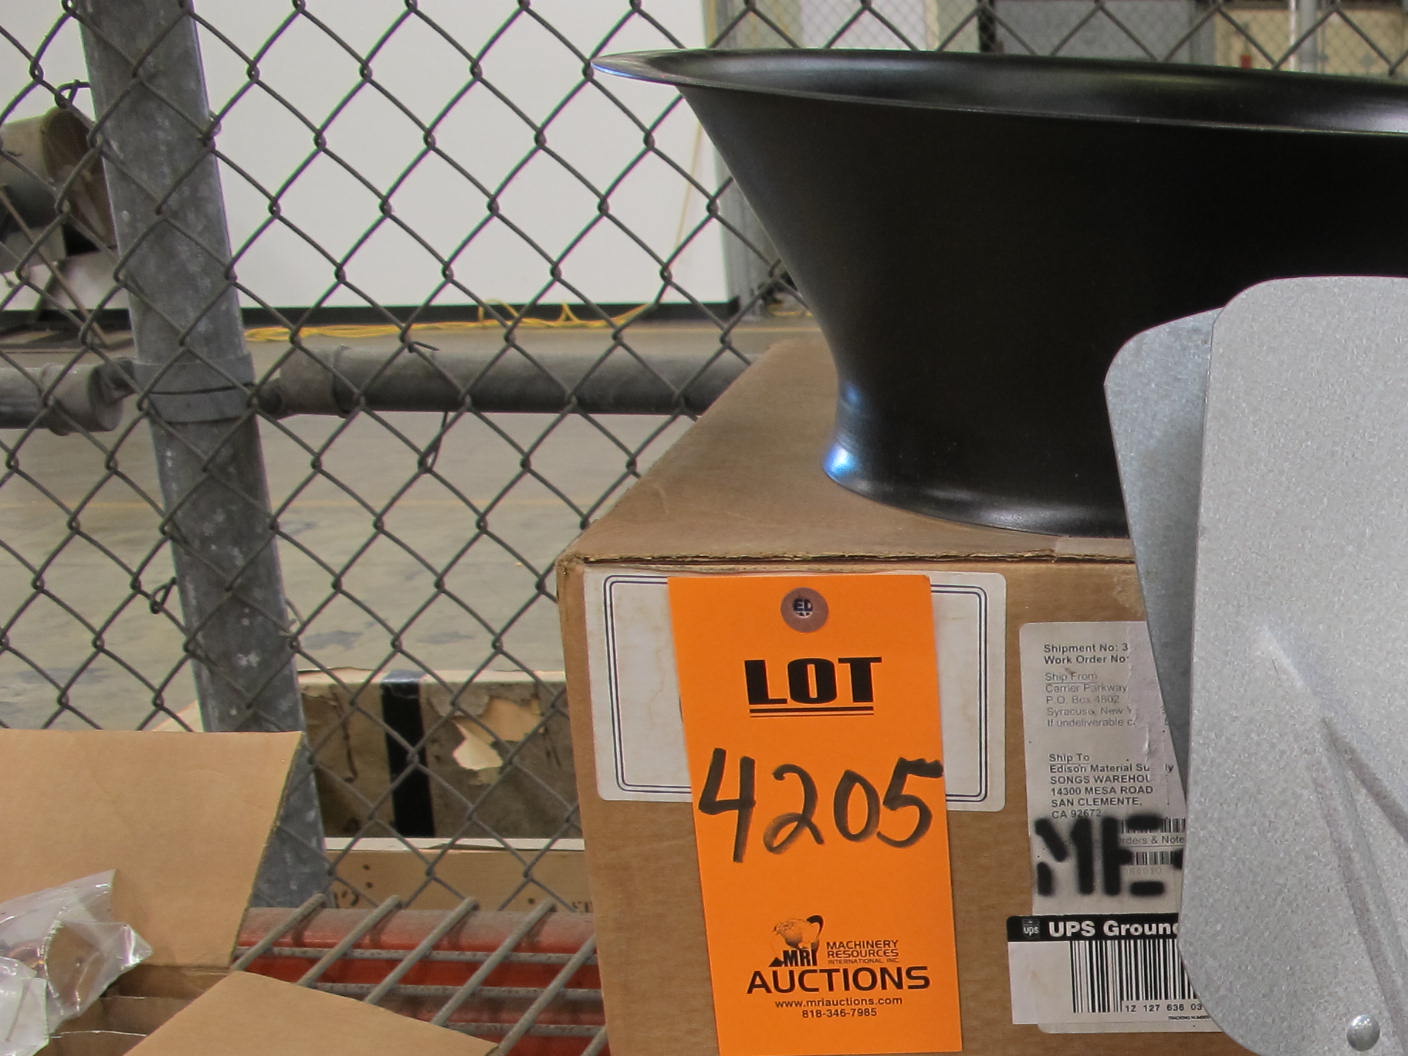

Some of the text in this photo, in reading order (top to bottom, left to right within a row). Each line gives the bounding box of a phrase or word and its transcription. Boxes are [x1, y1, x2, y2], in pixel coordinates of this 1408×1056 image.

[1044, 643, 1096, 655] Shipment
[1044, 656, 1072, 665] Work
[1076, 655, 1106, 664] Order
[744, 657, 882, 705] LOT
[1044, 672, 1098, 683] Ship From
[1045, 684, 1128, 694] Carrier Parkway
[1057, 718, 1123, 728] undeliverable
[1049, 753, 1090, 763] Ship To
[1050, 764, 1086, 774] Edison
[1090, 764, 1132, 773] Material
[1050, 775, 1151, 785] SONGS WAREHOU
[1051, 786, 1154, 796] 14300 MESA ROAD
[698, 748, 943, 863] 4205
[1052, 798, 1143, 808] SAN CLEMENTE,
[1052, 810, 1067, 819] CA
[1035, 813, 1183, 896] ME
[1049, 920, 1096, 937] UPS
[826, 940, 899, 950] MACHINERY
[827, 949, 899, 958] RESOURCES
[746, 966, 931, 994] AUCTIONS
[775, 997, 902, 1008] www.mriauctions.com
[802, 1008, 877, 1018] 818-346-7985
[1143, 1004, 1160, 1012] 127
